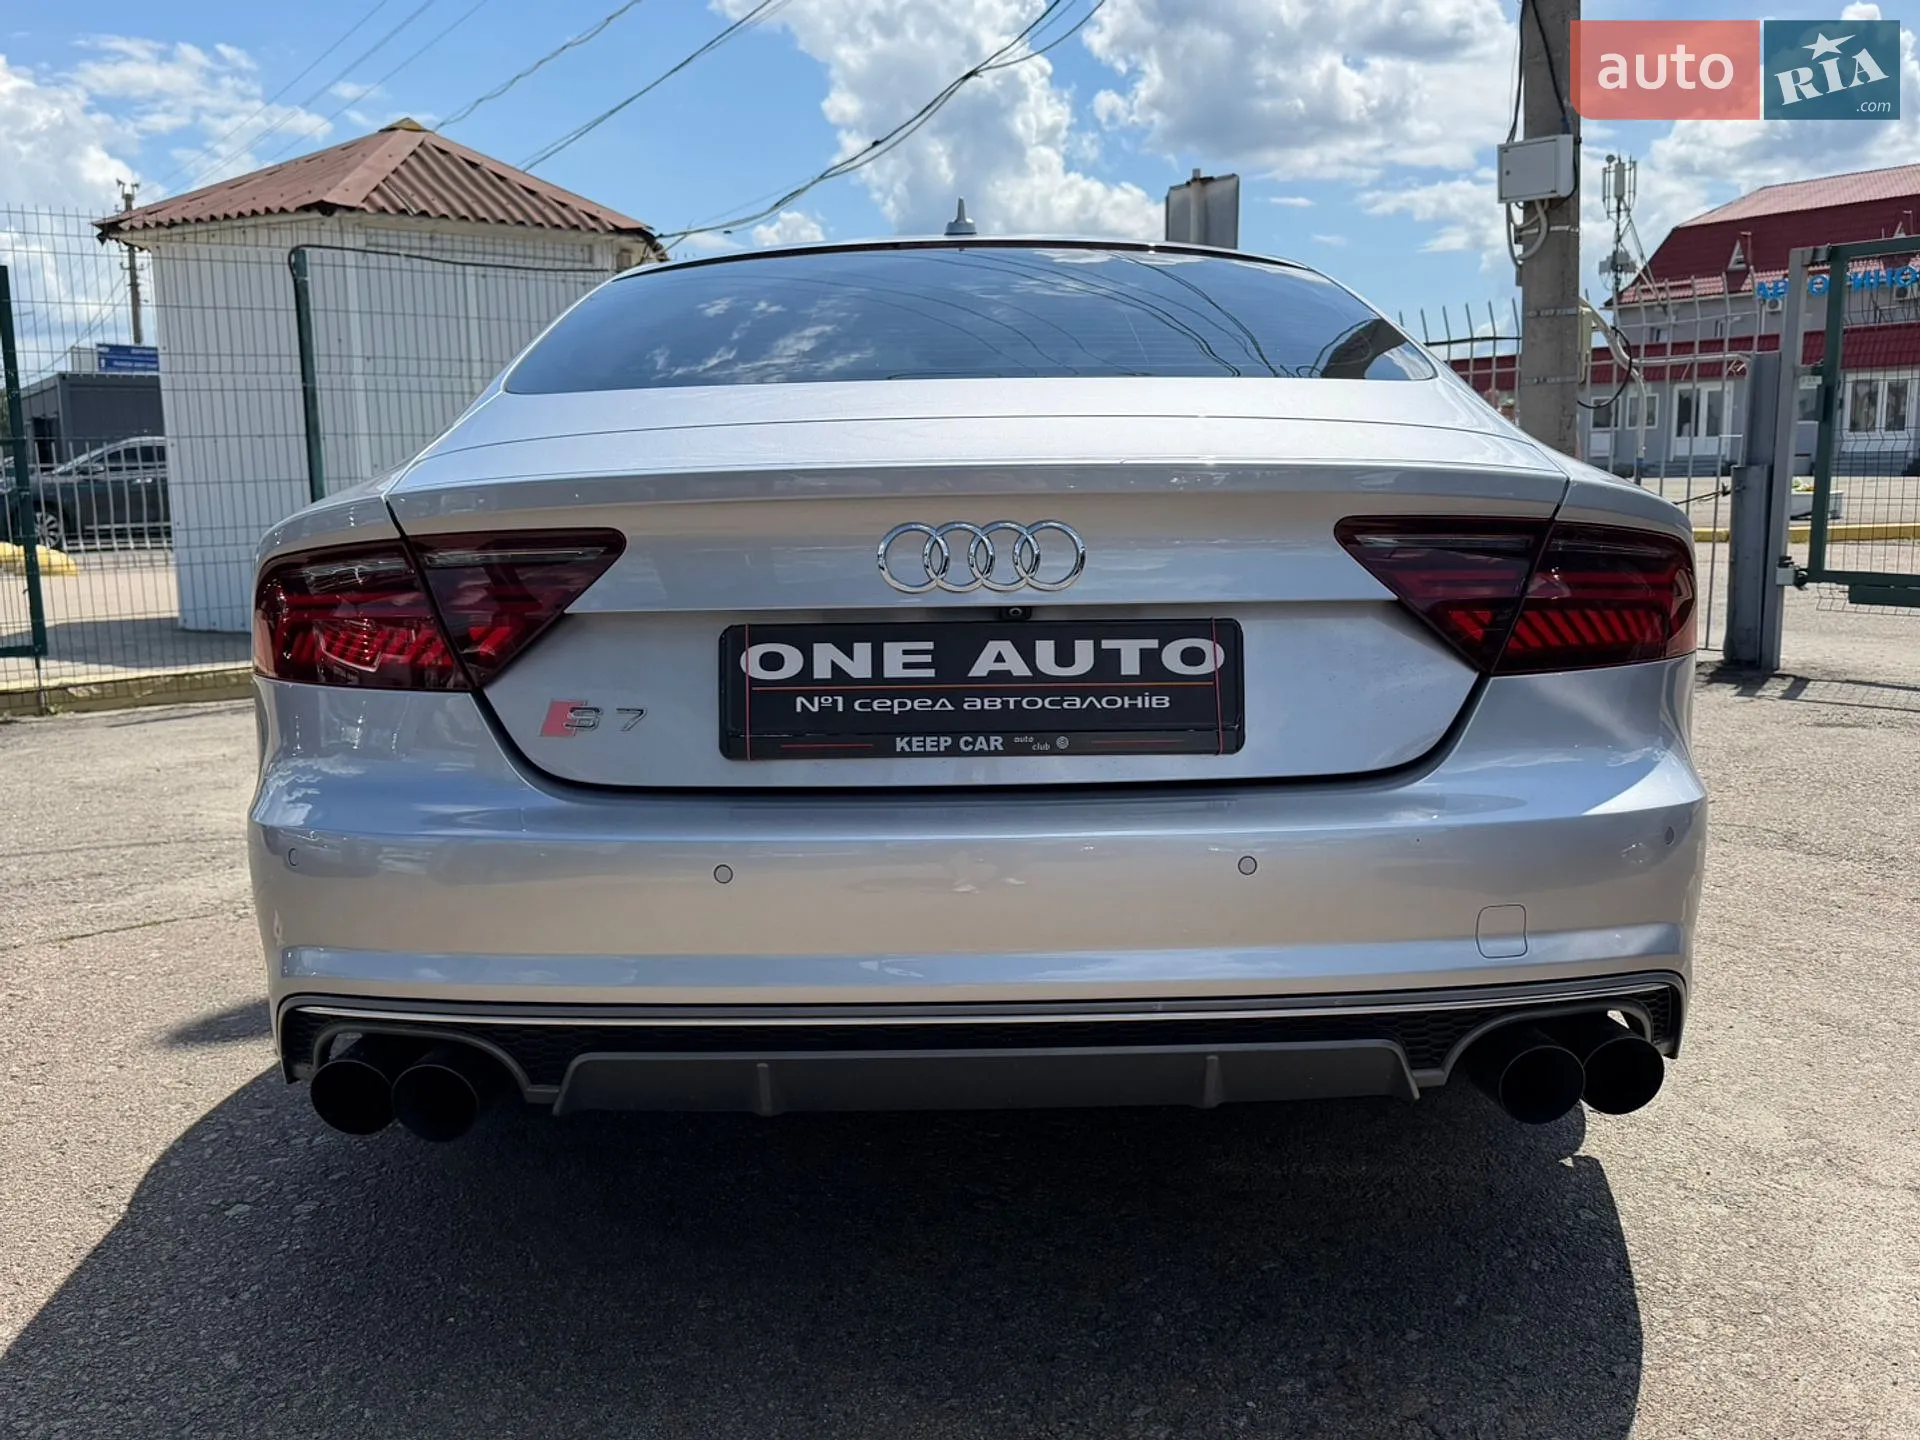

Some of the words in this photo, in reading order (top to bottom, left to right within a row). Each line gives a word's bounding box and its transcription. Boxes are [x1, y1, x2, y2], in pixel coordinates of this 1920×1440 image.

[739, 641, 936, 680] ONE
[967, 637, 1226, 677] AUTO
[853, 697, 956, 715] серед
[962, 692, 1171, 711] автосалонів
[895, 736, 952, 752] KEEP
[959, 735, 1004, 751] CAR
[1013, 735, 1035, 744] auto
[1031, 741, 1051, 751] club
